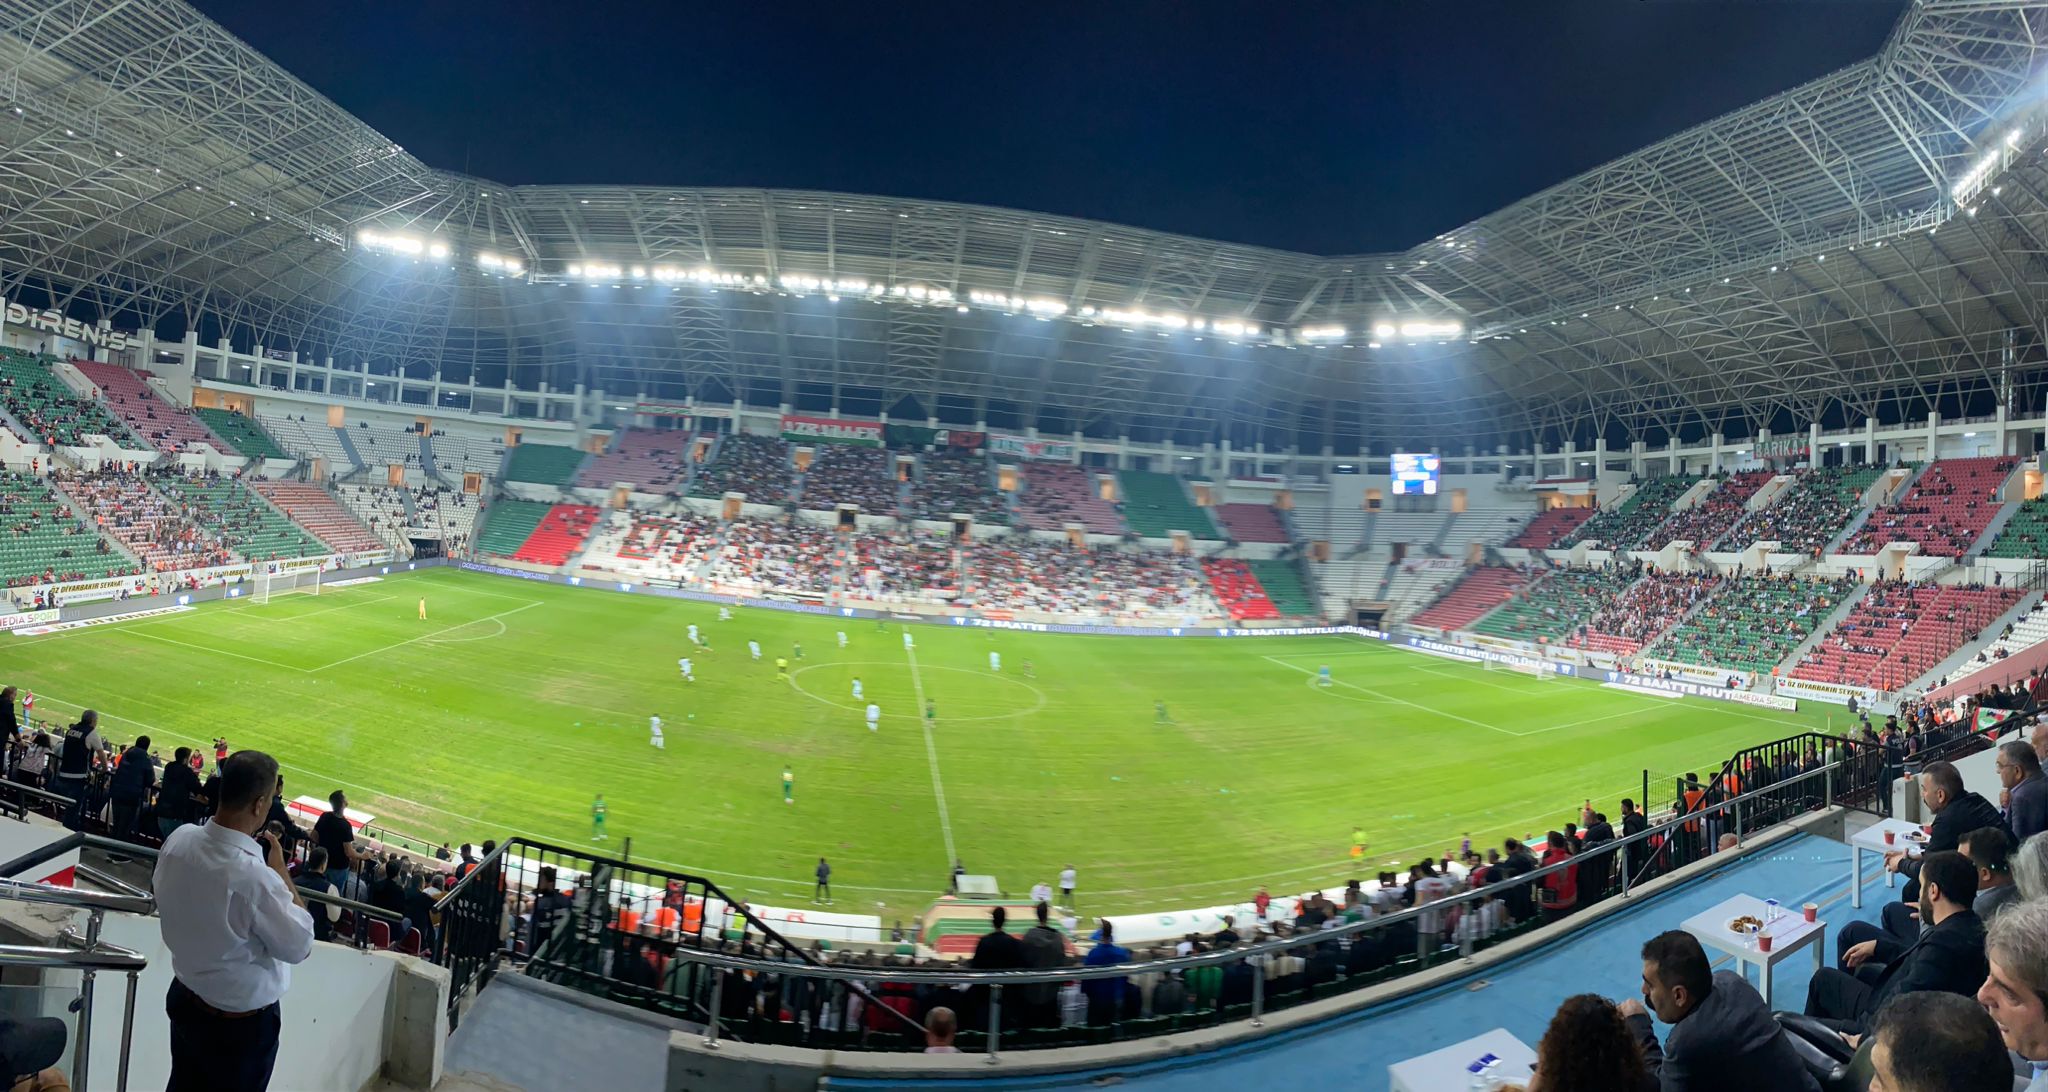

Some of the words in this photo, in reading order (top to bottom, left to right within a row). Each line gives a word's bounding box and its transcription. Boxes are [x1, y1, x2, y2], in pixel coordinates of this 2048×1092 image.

[1251, 628, 1297, 636] SAATTE
[1624, 674, 1640, 685] 72
[1642, 677, 1697, 694] SAATTE
